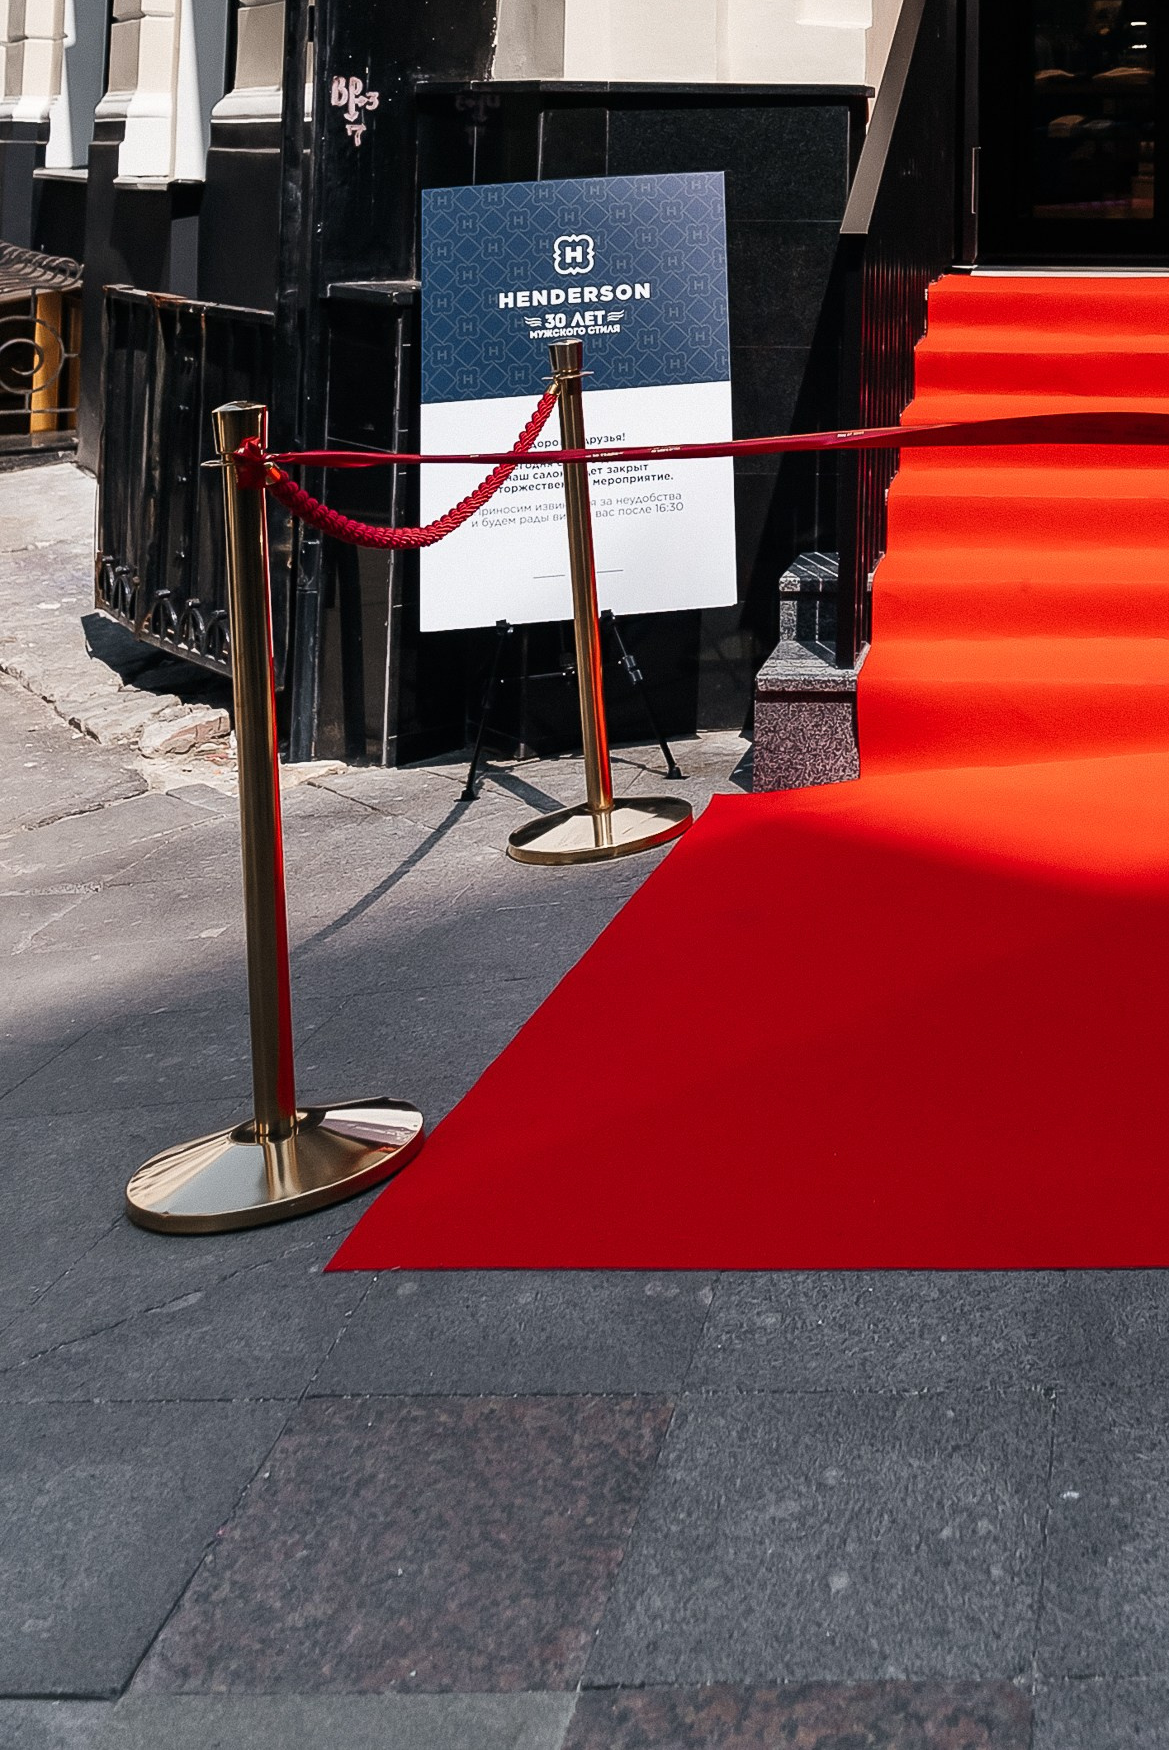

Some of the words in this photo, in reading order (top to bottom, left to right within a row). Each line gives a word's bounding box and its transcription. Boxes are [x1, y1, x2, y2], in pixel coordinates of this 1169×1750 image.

[498, 283, 651, 309] HENDERSON
[544, 313, 566, 329] 30
[570, 310, 606, 328] ЛЕТ
[529, 326, 586, 339] МУЖСКОГО
[587, 324, 621, 335] СТИЛЯ
[606, 463, 649, 475] закрыт
[592, 473, 674, 486] мероприятие.
[600, 498, 613, 507] за
[616, 492, 682, 506] неудобства
[481, 517, 516, 529] будем
[519, 515, 549, 525] рады
[595, 509, 615, 518] вас
[618, 506, 652, 516] после
[655, 501, 684, 513] 16:30
